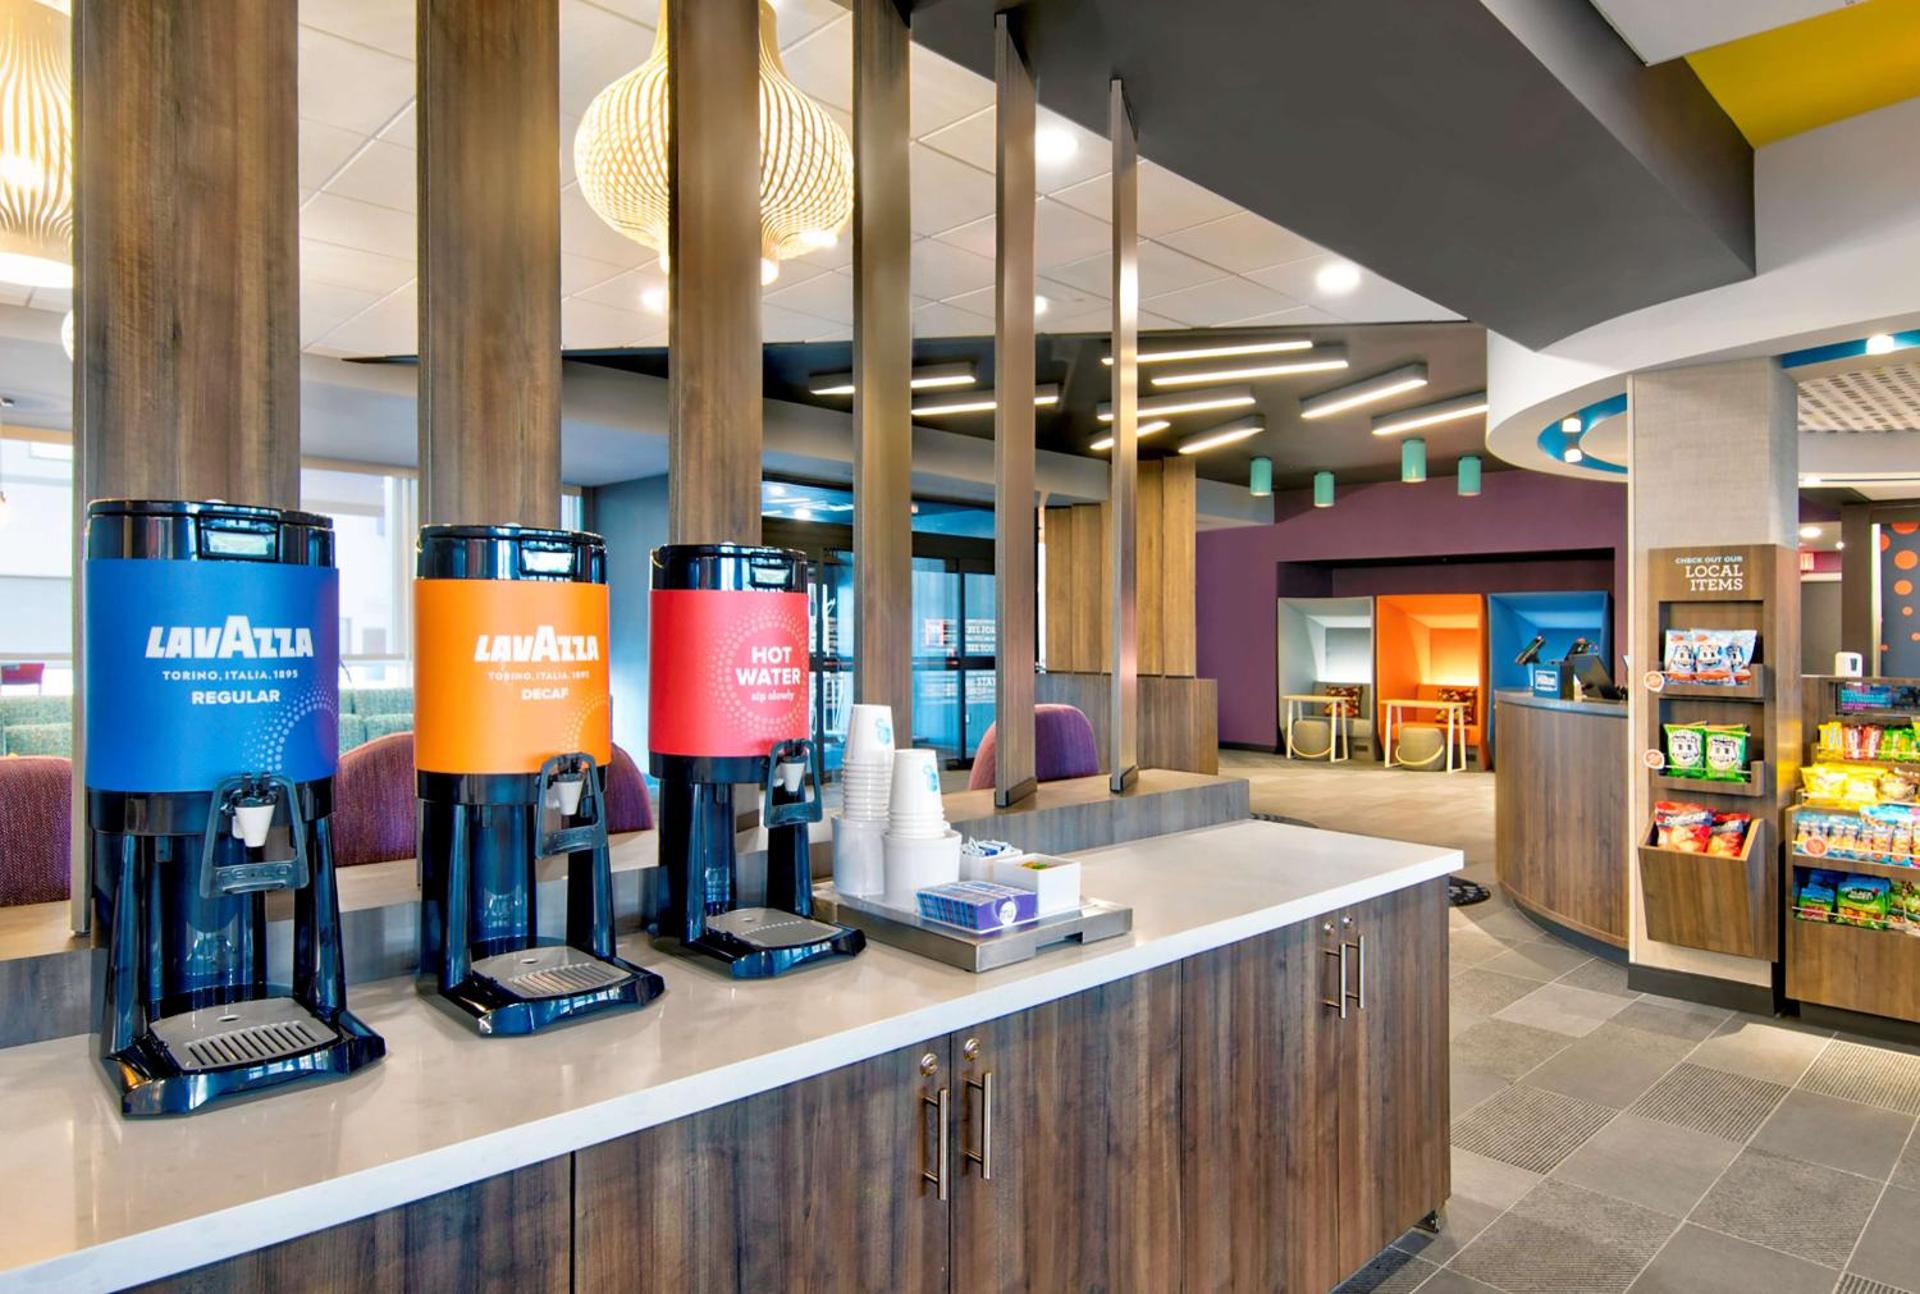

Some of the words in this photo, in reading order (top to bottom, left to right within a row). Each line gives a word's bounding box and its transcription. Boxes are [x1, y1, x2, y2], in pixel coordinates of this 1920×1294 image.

[1685, 564, 1743, 578] LOCAL
[1690, 578, 1743, 591] ITEMS
[145, 615, 314, 659] LAVAZZA
[474, 625, 599, 662] LAVAZZA
[751, 646, 792, 664] HOT
[273, 669, 298, 679] 1895
[736, 667, 801, 686] WATER
[191, 690, 280, 704] REGULAR
[521, 688, 569, 700] DECAF
